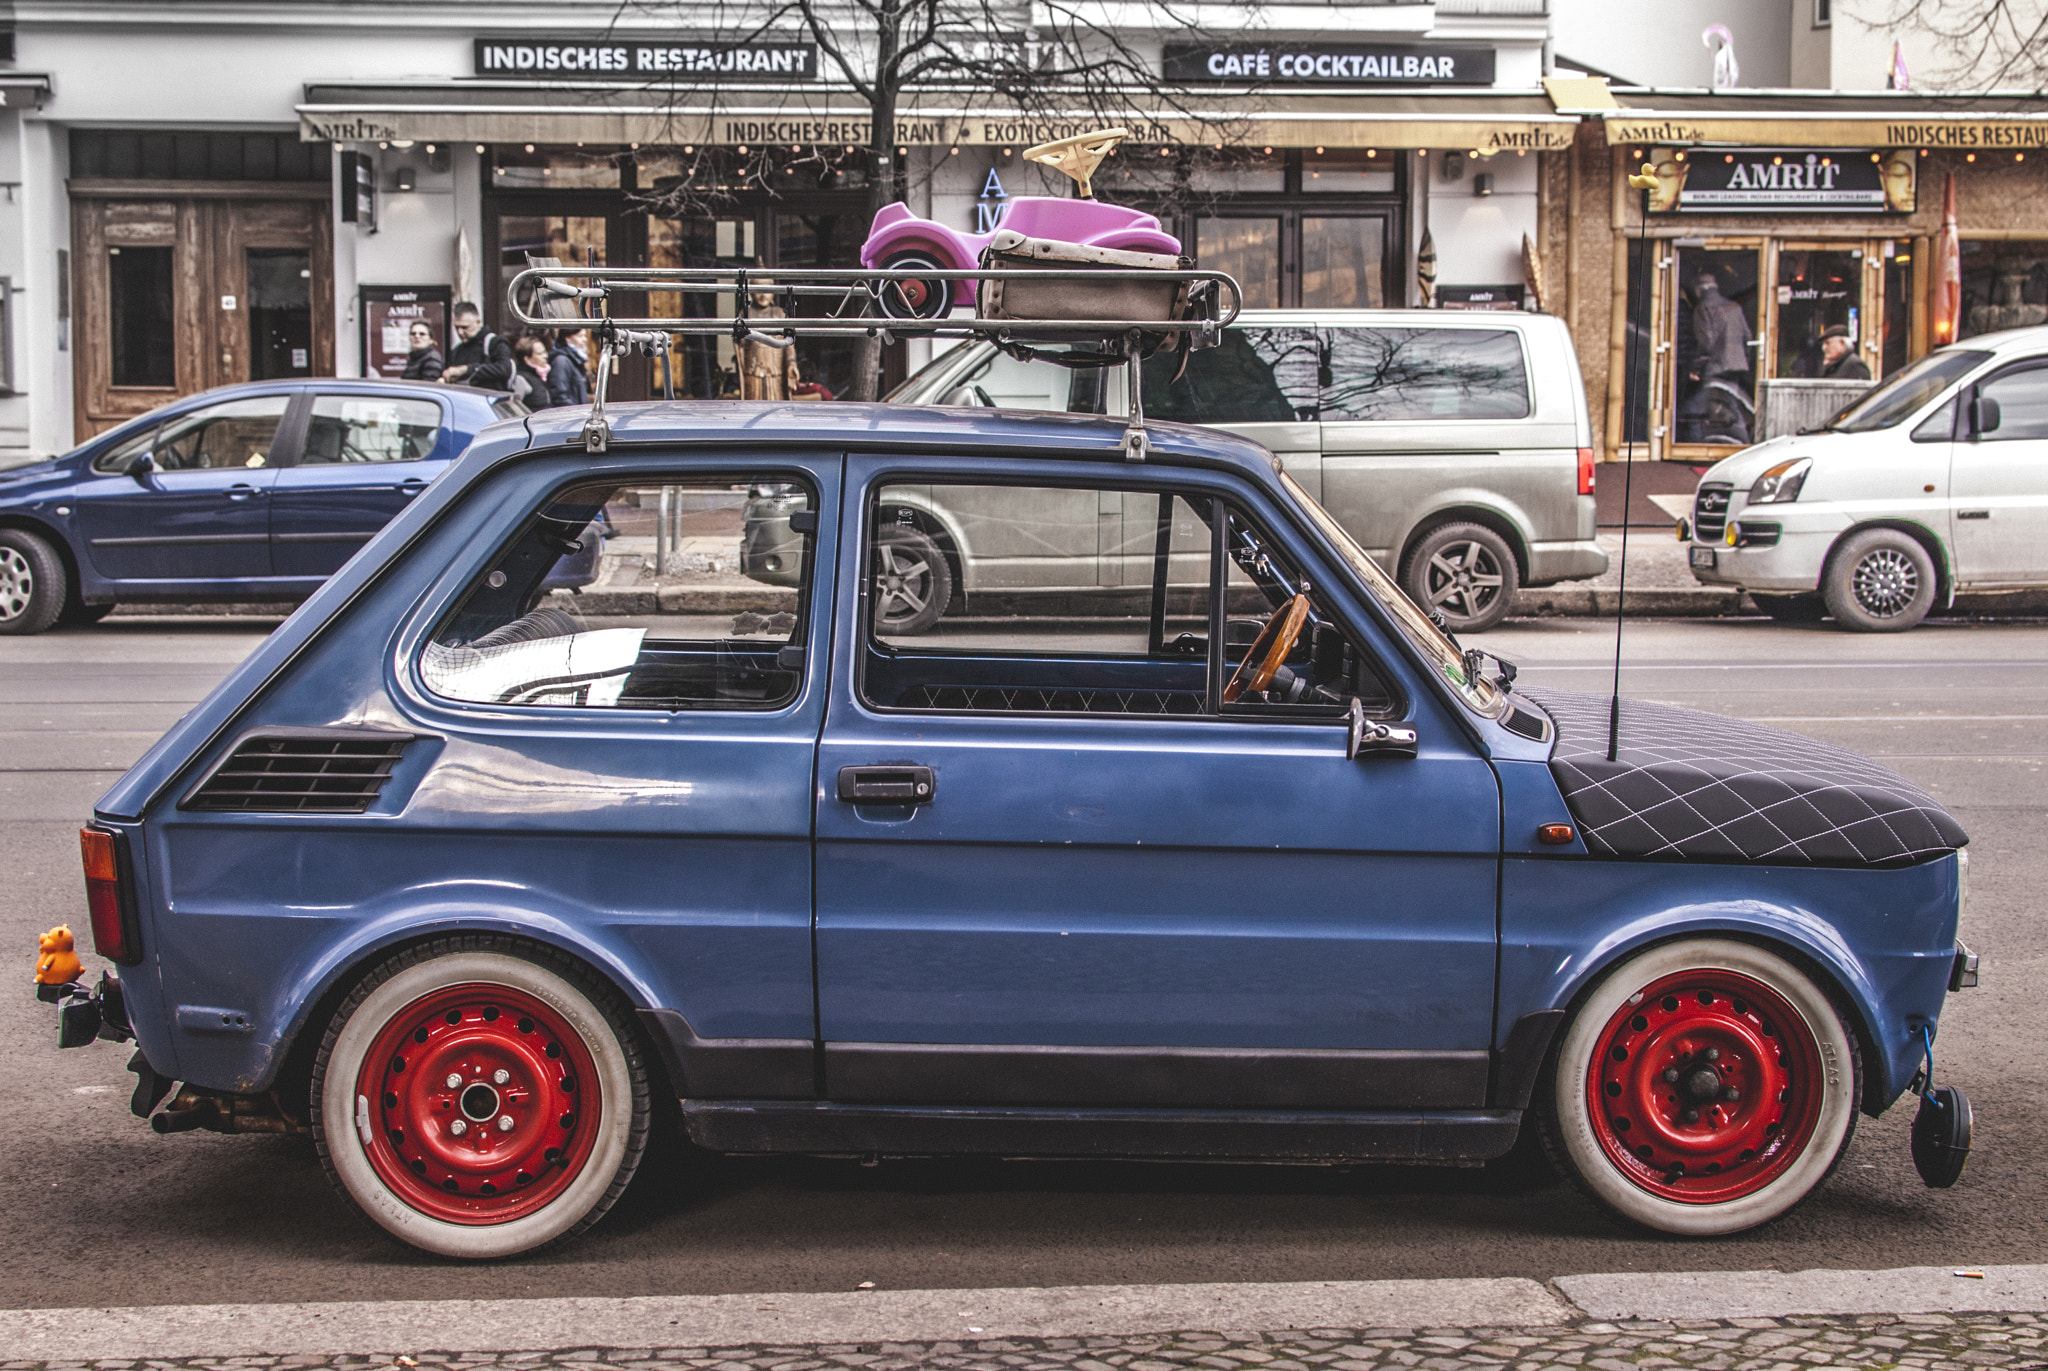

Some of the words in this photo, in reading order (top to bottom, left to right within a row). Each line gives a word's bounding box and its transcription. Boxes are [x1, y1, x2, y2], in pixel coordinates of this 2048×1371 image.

[483, 46, 629, 70] INDISCHES
[636, 48, 808, 72] RESTAURANT
[1207, 49, 1270, 76] CAFÉ
[1278, 54, 1455, 78] COCKTAILBAR
[726, 122, 823, 142] INDISCHES
[828, 123, 945, 142] RESTRANT
[1887, 126, 1978, 144] INDISCHES
[1822, 1042, 1840, 1085] ATLAS
[373, 1189, 414, 1224] ATLAS
